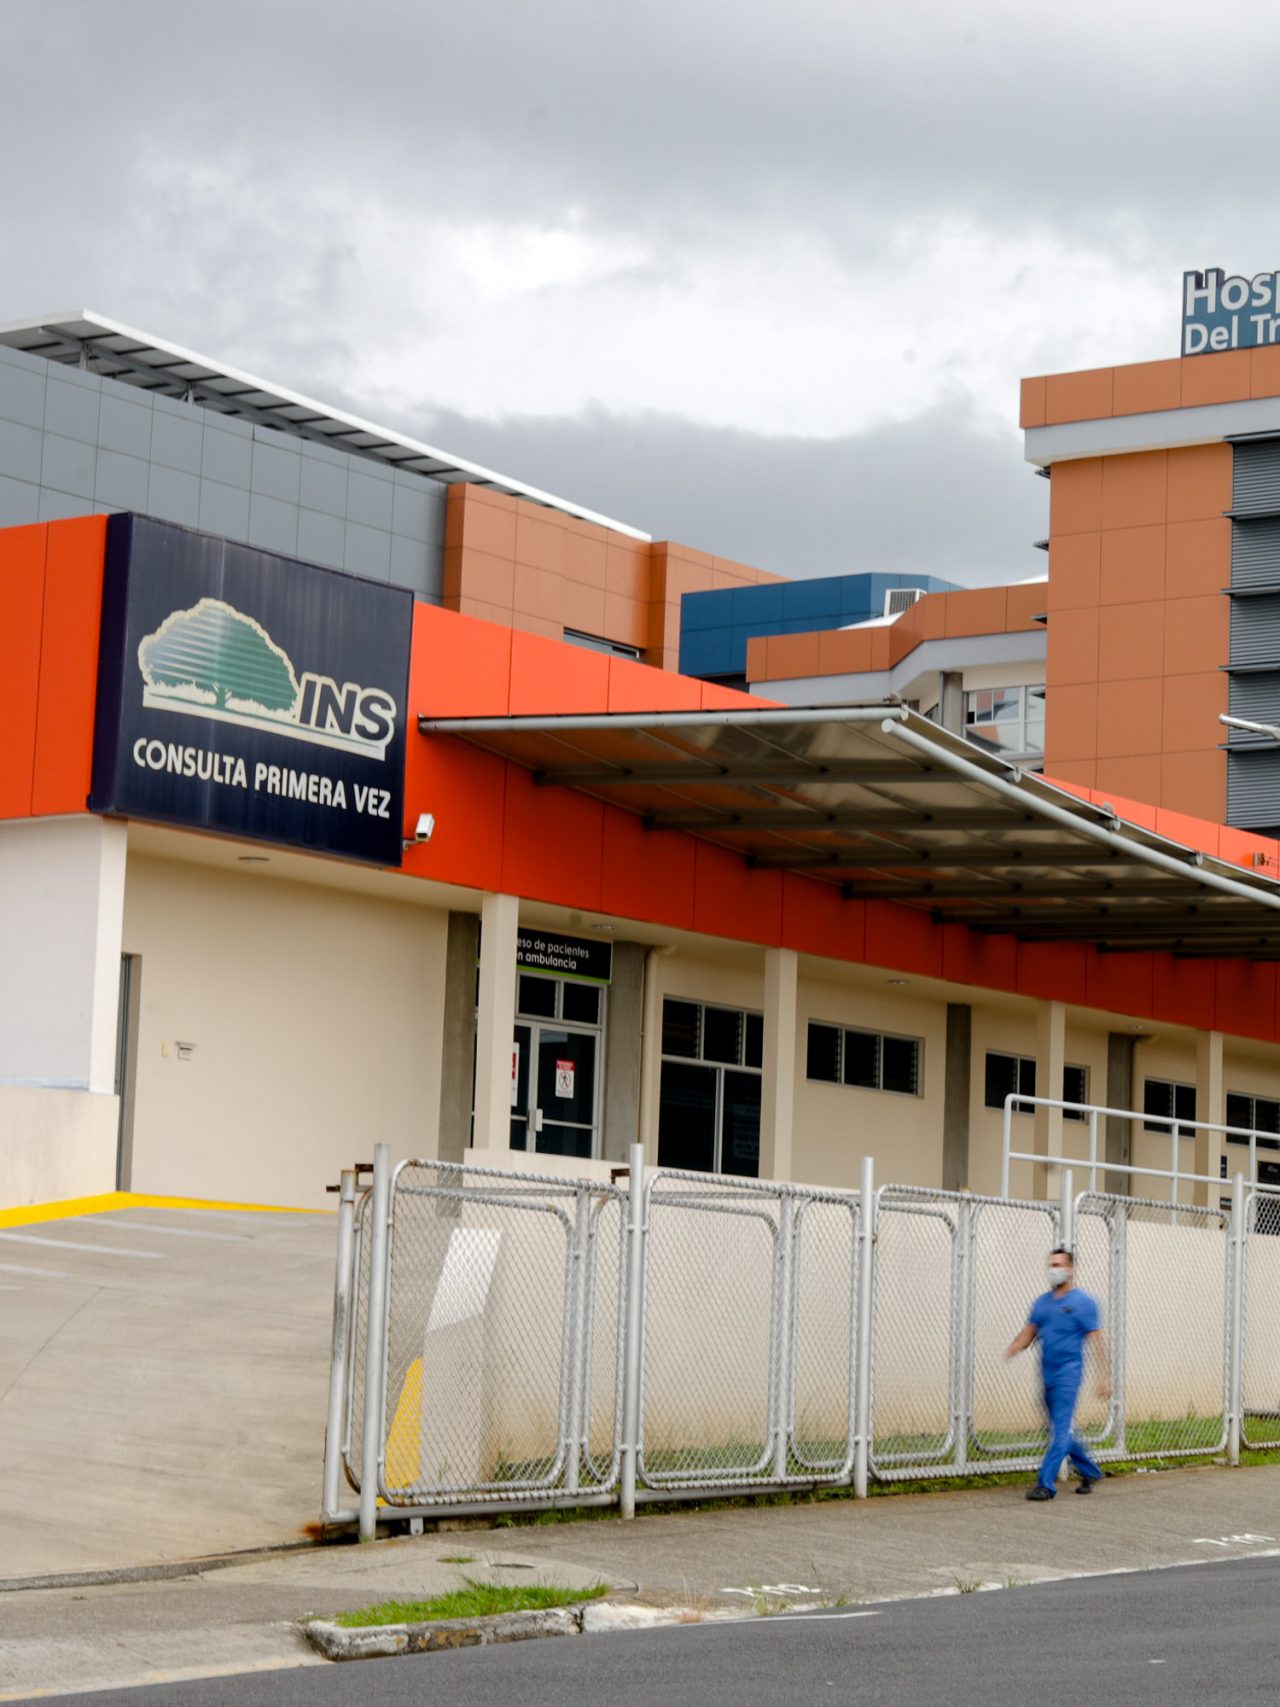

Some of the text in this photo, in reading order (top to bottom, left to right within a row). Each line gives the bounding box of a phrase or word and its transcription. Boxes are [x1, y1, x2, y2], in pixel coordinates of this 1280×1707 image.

[1184, 314, 1239, 355] Del
[299, 673, 396, 743] INS
[132, 738, 391, 819] CONSULTA PRIMERA VEZ
[525, 952, 577, 970] ambulancia
[534, 939, 546, 951] de
[547, 943, 589, 959] pacientes
